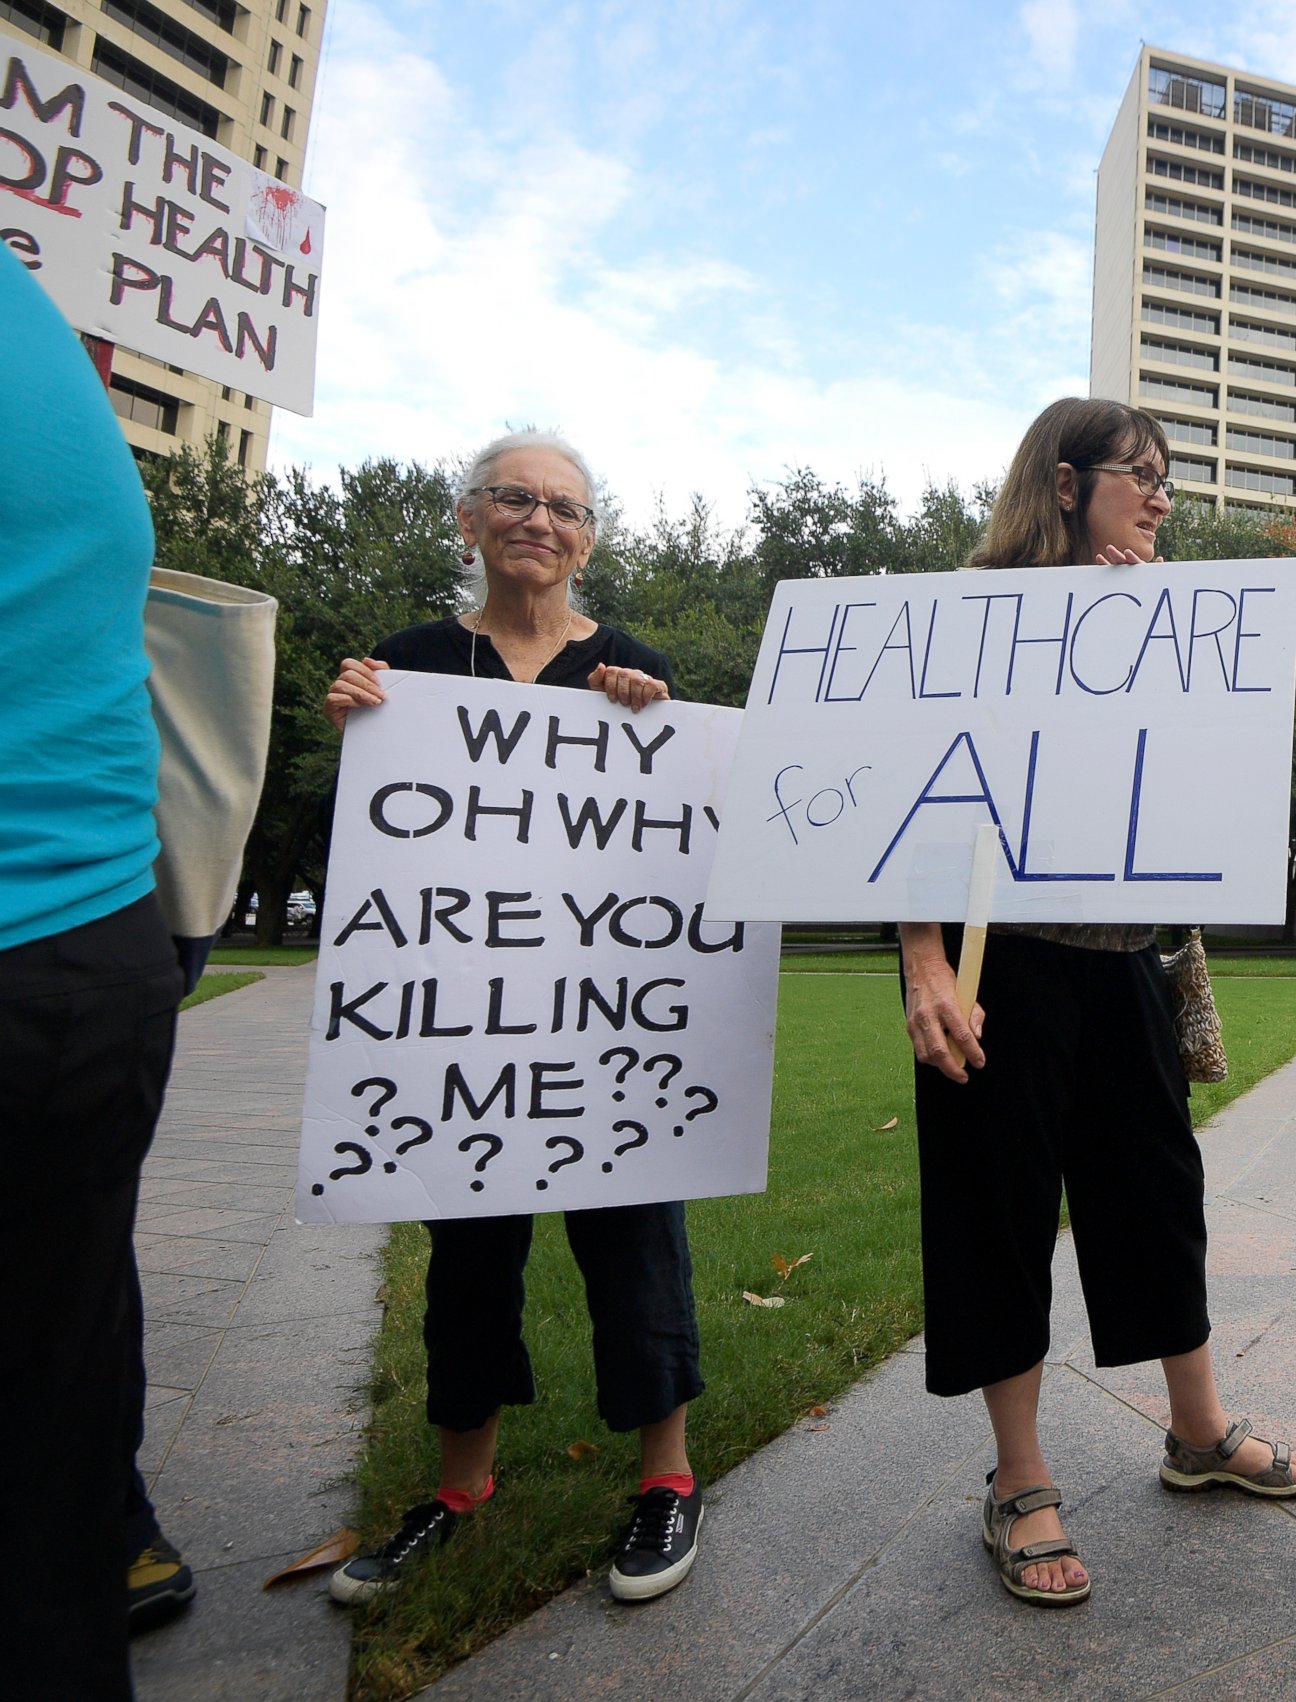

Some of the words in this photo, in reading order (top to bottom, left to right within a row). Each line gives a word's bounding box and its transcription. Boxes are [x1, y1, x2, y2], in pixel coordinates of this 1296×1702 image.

[107, 101, 233, 214] THE
[0, 127, 103, 205] OP
[120, 181, 318, 317] HEALTH
[110, 252, 278, 371] PLAN
[767, 588, 1276, 703] HEALTHCARE
[456, 705, 675, 775] WHY
[369, 782, 534, 843] OH
[557, 793, 719, 854] WH
[766, 764, 872, 845] for
[867, 728, 1223, 884] ALL
[334, 888, 546, 948] ARE
[561, 893, 744, 953] YOU
[325, 977, 689, 1041] KILLING
